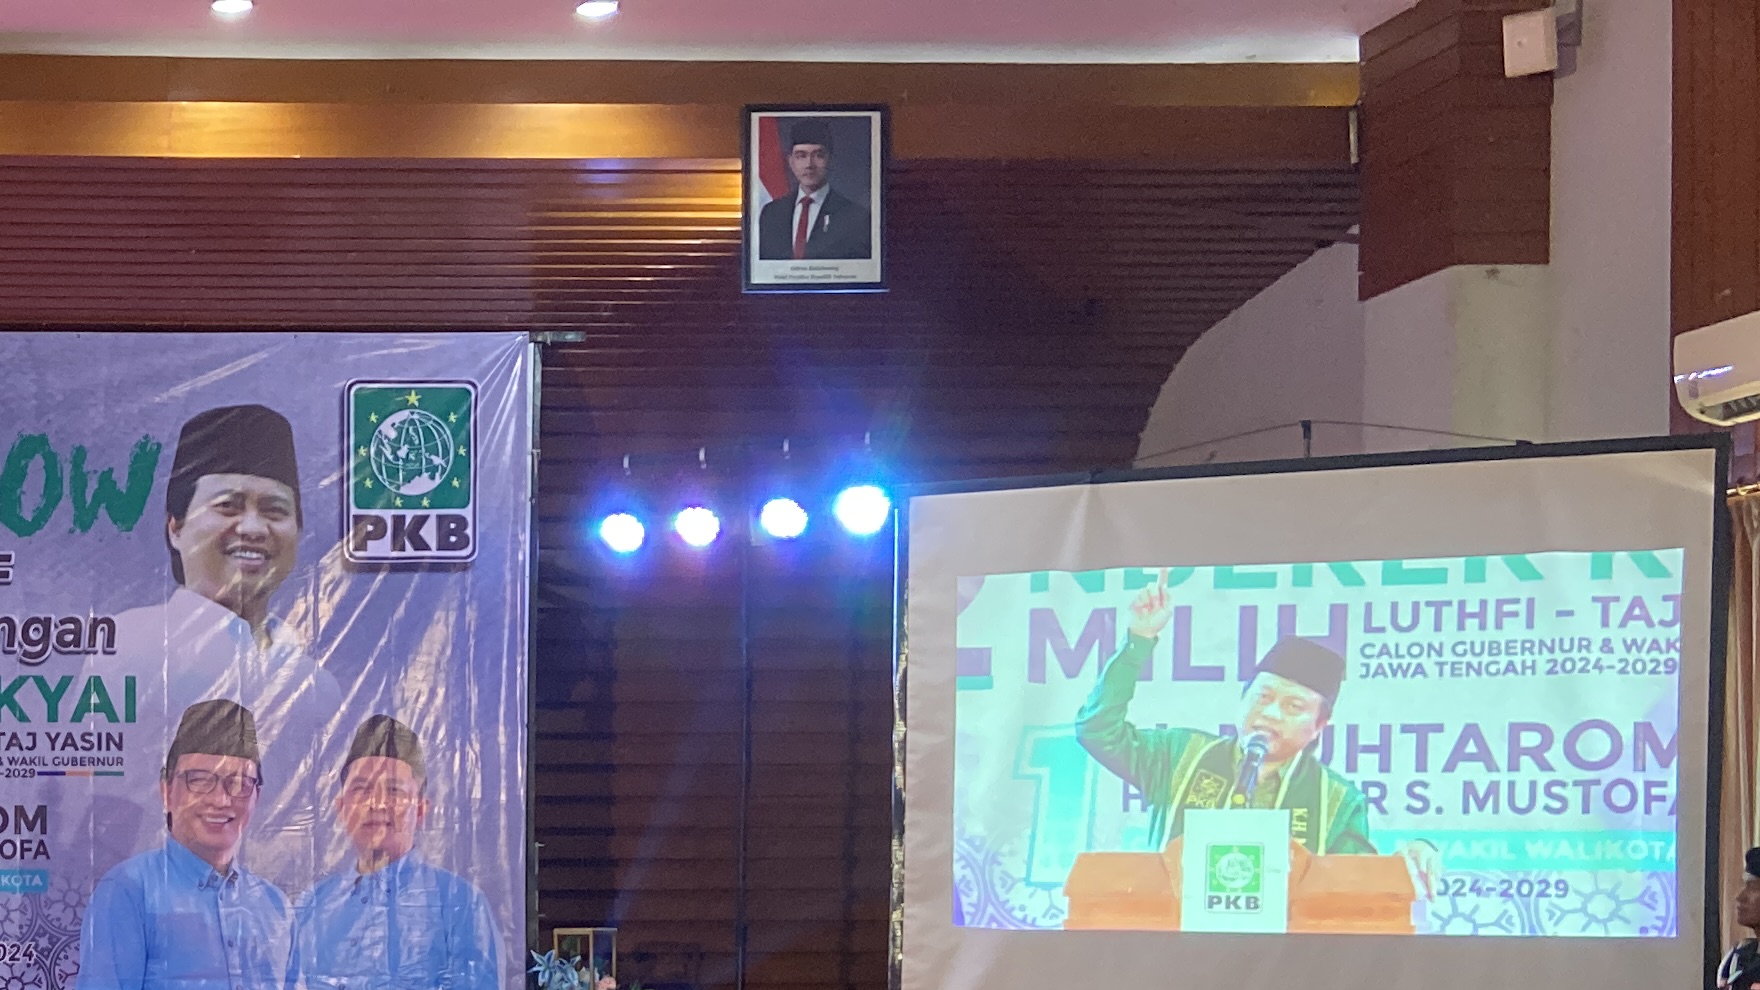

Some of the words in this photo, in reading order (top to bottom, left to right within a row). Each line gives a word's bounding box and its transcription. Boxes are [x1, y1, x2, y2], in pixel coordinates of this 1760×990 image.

[352, 514, 471, 552] PKB
[1363, 597, 1535, 634] LUTHFI
[1591, 594, 1681, 629] TAJ
[1028, 603, 1348, 684] MLIH
[1359, 641, 1443, 660] CALON
[1451, 637, 1590, 657] GUBERNUR
[1599, 638, 1615, 655] &
[1622, 637, 1681, 655] WAK
[1359, 661, 1428, 679] JAWA
[1435, 659, 1537, 678] TENGAH
[1544, 657, 1678, 676] 2024-2029
[44, 732, 124, 751] YASIN
[7, 756, 49, 767] WAKIL
[52, 756, 124, 767] GUBERNUR
[1405, 779, 1444, 815] S.
[1462, 778, 1678, 816] MUSTOF
[1207, 895, 1260, 910] PKB
